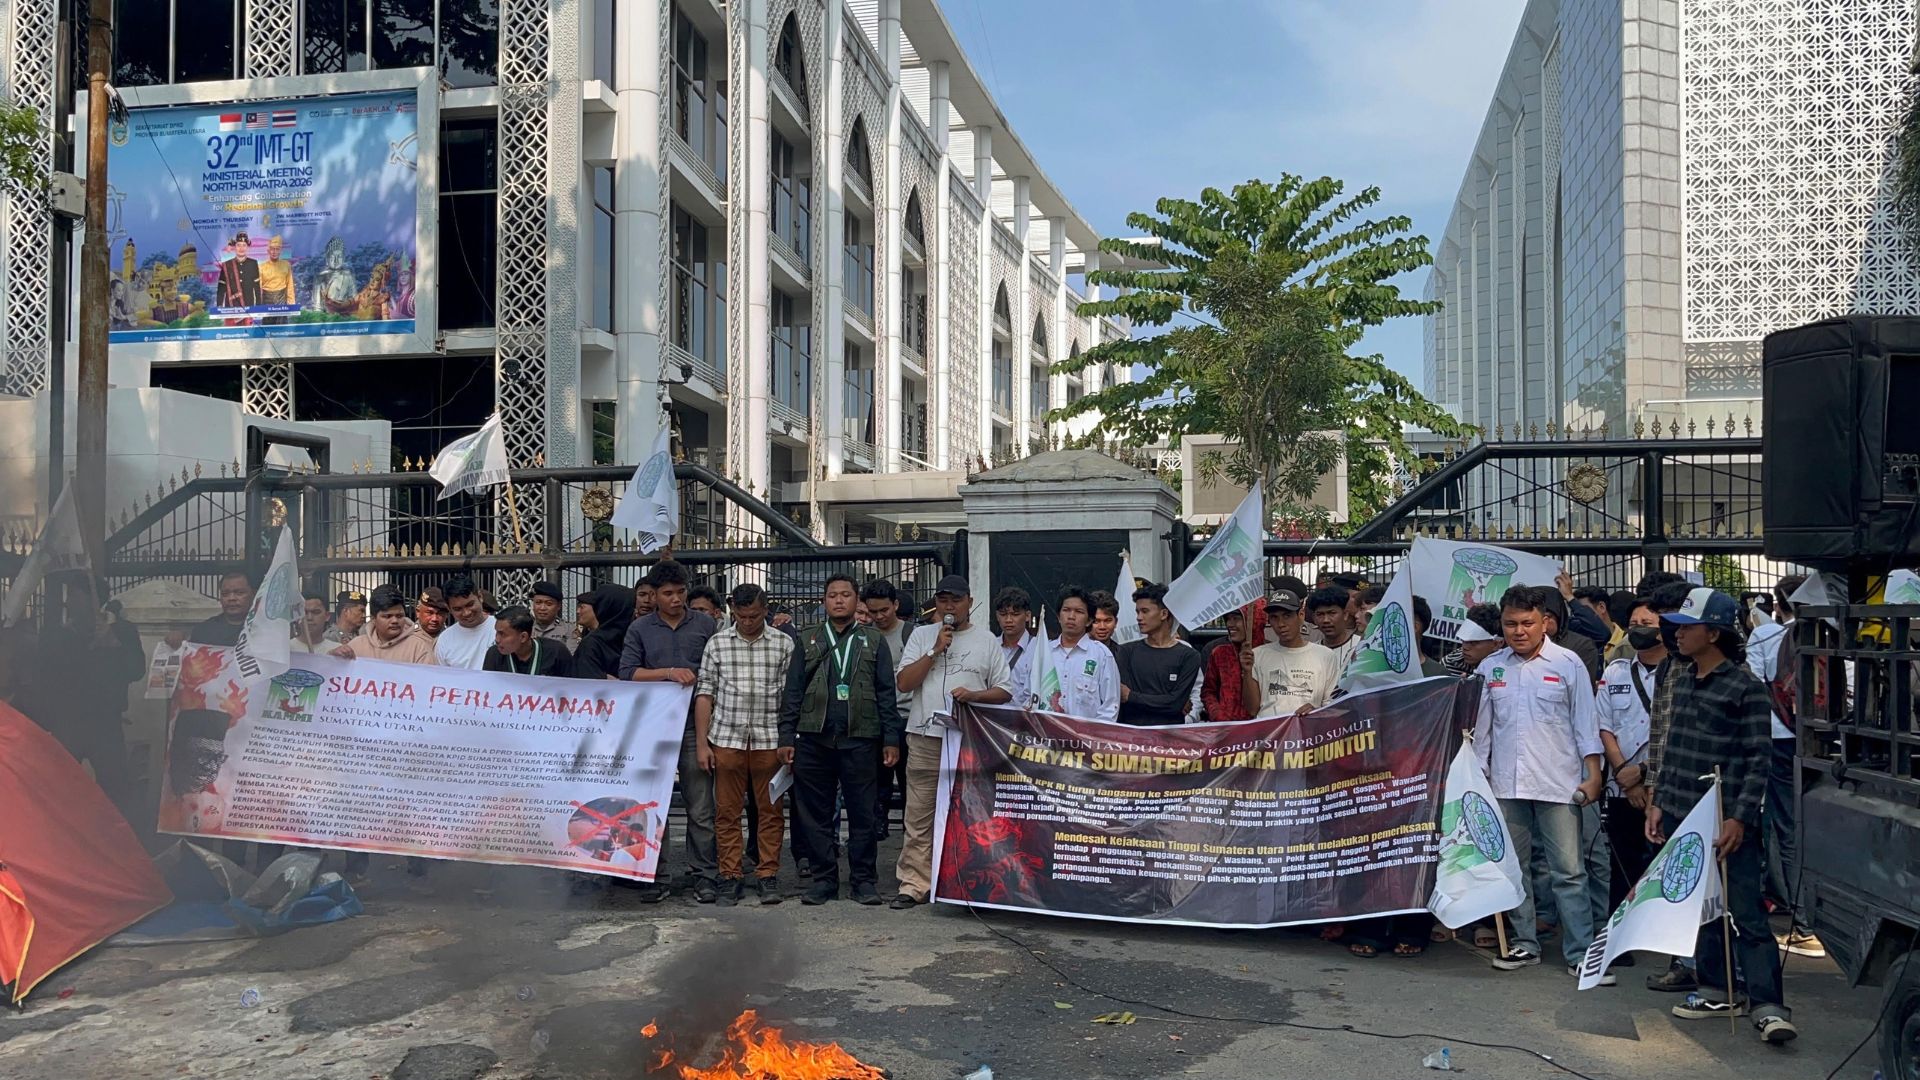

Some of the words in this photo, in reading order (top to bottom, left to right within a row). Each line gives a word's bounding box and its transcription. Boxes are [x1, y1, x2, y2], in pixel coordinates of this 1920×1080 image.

[207, 133, 252, 169] 32nd
[255, 131, 314, 165] IMT-GT
[202, 170, 265, 181] MINISTERIAL
[266, 166, 313, 178] MEETING
[203, 181, 237, 192] NORTH
[240, 179, 288, 190] SUMATRA
[289, 178, 312, 188] 2026
[224, 202, 267, 213] Regional
[255, 191, 312, 200] Collaboration
[328, 677, 415, 704] SUARA
[430, 686, 615, 718] PERLAWANAN
[1270, 688, 1294, 696] Batam
[261, 709, 314, 723] KAMMI
[319, 715, 380, 728] SUMATERA
[384, 721, 424, 732] UTARA
[322, 705, 382, 718] KESATUAN
[385, 711, 412, 720] AKSI
[415, 713, 486, 728] MAHASISWA
[490, 721, 536, 731] MUSLIM
[538, 725, 602, 734] INDONESIA
[253, 725, 301, 736] MENDESAK
[302, 730, 327, 738] KETUA
[330, 733, 351, 741] DPRD
[353, 736, 398, 745] SUMATERA
[400, 740, 428, 748] UTARA
[450, 744, 480, 752] KOMISI
[514, 749, 558, 757] SUMATERA
[589, 753, 634, 761] MENINJAU
[1013, 734, 1051, 746] USUT
[1058, 739, 1122, 751] TUNTAS
[1128, 743, 1202, 755] DUGAAN
[1208, 739, 1277, 755] KORUPSI
[1284, 734, 1323, 750] DPRD
[1326, 719, 1373, 740] SUMUT
[1008, 743, 1084, 768] RAKYAT
[1091, 753, 1202, 774] SUMATERA
[1209, 750, 1275, 770] UTARA
[1283, 730, 1375, 770] MENUNTUT
[236, 779, 298, 791] MEMBATALKAN
[300, 785, 350, 796] PENETAPAN
[351, 790, 404, 801] MUHAMMAD
[406, 795, 440, 804] YUSRON
[442, 798, 478, 807] SEBAGAI
[480, 801, 520, 810] ANGGOTA
[523, 804, 542, 812] KPID
[544, 806, 574, 814] SUMUT
[995, 772, 1032, 784] Meminta
[1035, 777, 1052, 788] KPK
[1067, 784, 1095, 795] turun
[1097, 788, 1146, 799] langsung
[1163, 787, 1212, 797] Sumatera
[1215, 788, 1242, 797] Utara
[1246, 790, 1276, 800] untuk
[1280, 785, 1329, 799] melakukan
[232, 803, 288, 815] NONPARTISAN
[310, 811, 334, 819] TIDAK
[336, 813, 383, 823] MEMENUHI
[387, 817, 447, 829] PERSYARATAN
[450, 823, 483, 832] TERKAIT
[1030, 802, 1054, 812] terjadi
[1230, 819, 1262, 827] maupun
[1265, 818, 1292, 826] praktik
[1295, 816, 1313, 825] yang
[1316, 812, 1332, 822] tidak
[1333, 806, 1357, 818] sesuai
[1359, 801, 1387, 815] dengan
[1391, 792, 1427, 807] ketentuan
[226, 820, 296, 832] DIPERSYARATKAN
[298, 826, 326, 835] DALAM
[328, 829, 354, 837] PASAL
[383, 834, 415, 843] NOMOR
[430, 838, 458, 846] TAHUN
[460, 840, 481, 848] 2002
[485, 843, 524, 852] TENTANG
[1054, 831, 1106, 844] Mendesak
[1109, 835, 1164, 850] Kejaksaan
[1168, 840, 1199, 852] Tinggi
[1202, 843, 1254, 854] Sumatera
[1256, 845, 1283, 854] Utara
[1286, 842, 1314, 852] untuk
[1317, 834, 1369, 850] melakukan
[1371, 821, 1435, 842] pemeriksaan
[1054, 842, 1088, 853] terhadap
[1091, 845, 1141, 858] penggunaan
[1145, 850, 1184, 861] anggaran
[1285, 853, 1305, 861] Pokir
[1308, 849, 1337, 859] seluruh
[1340, 844, 1369, 856] Anggota
[1372, 839, 1389, 849] DPRD
[1392, 833, 1431, 846] Sumatera
[1052, 861, 1136, 876] pertanggungjawaban
[1183, 873, 1205, 881] serta
[1207, 875, 1256, 883] pihak-pihak
[1279, 873, 1306, 882] diduga
[1336, 865, 1362, 876] apabila
[1363, 857, 1402, 871] ditemukan
[1404, 855, 1437, 864] indikasi
[1053, 851, 1090, 863] termasuk
[1098, 856, 1145, 867] memeriksa
[1153, 861, 1202, 871] mekanisme
[1281, 860, 1329, 872] pelaksanaan
[1377, 845, 1413, 859] penerima
[1052, 871, 1111, 883] penyimpangan.
